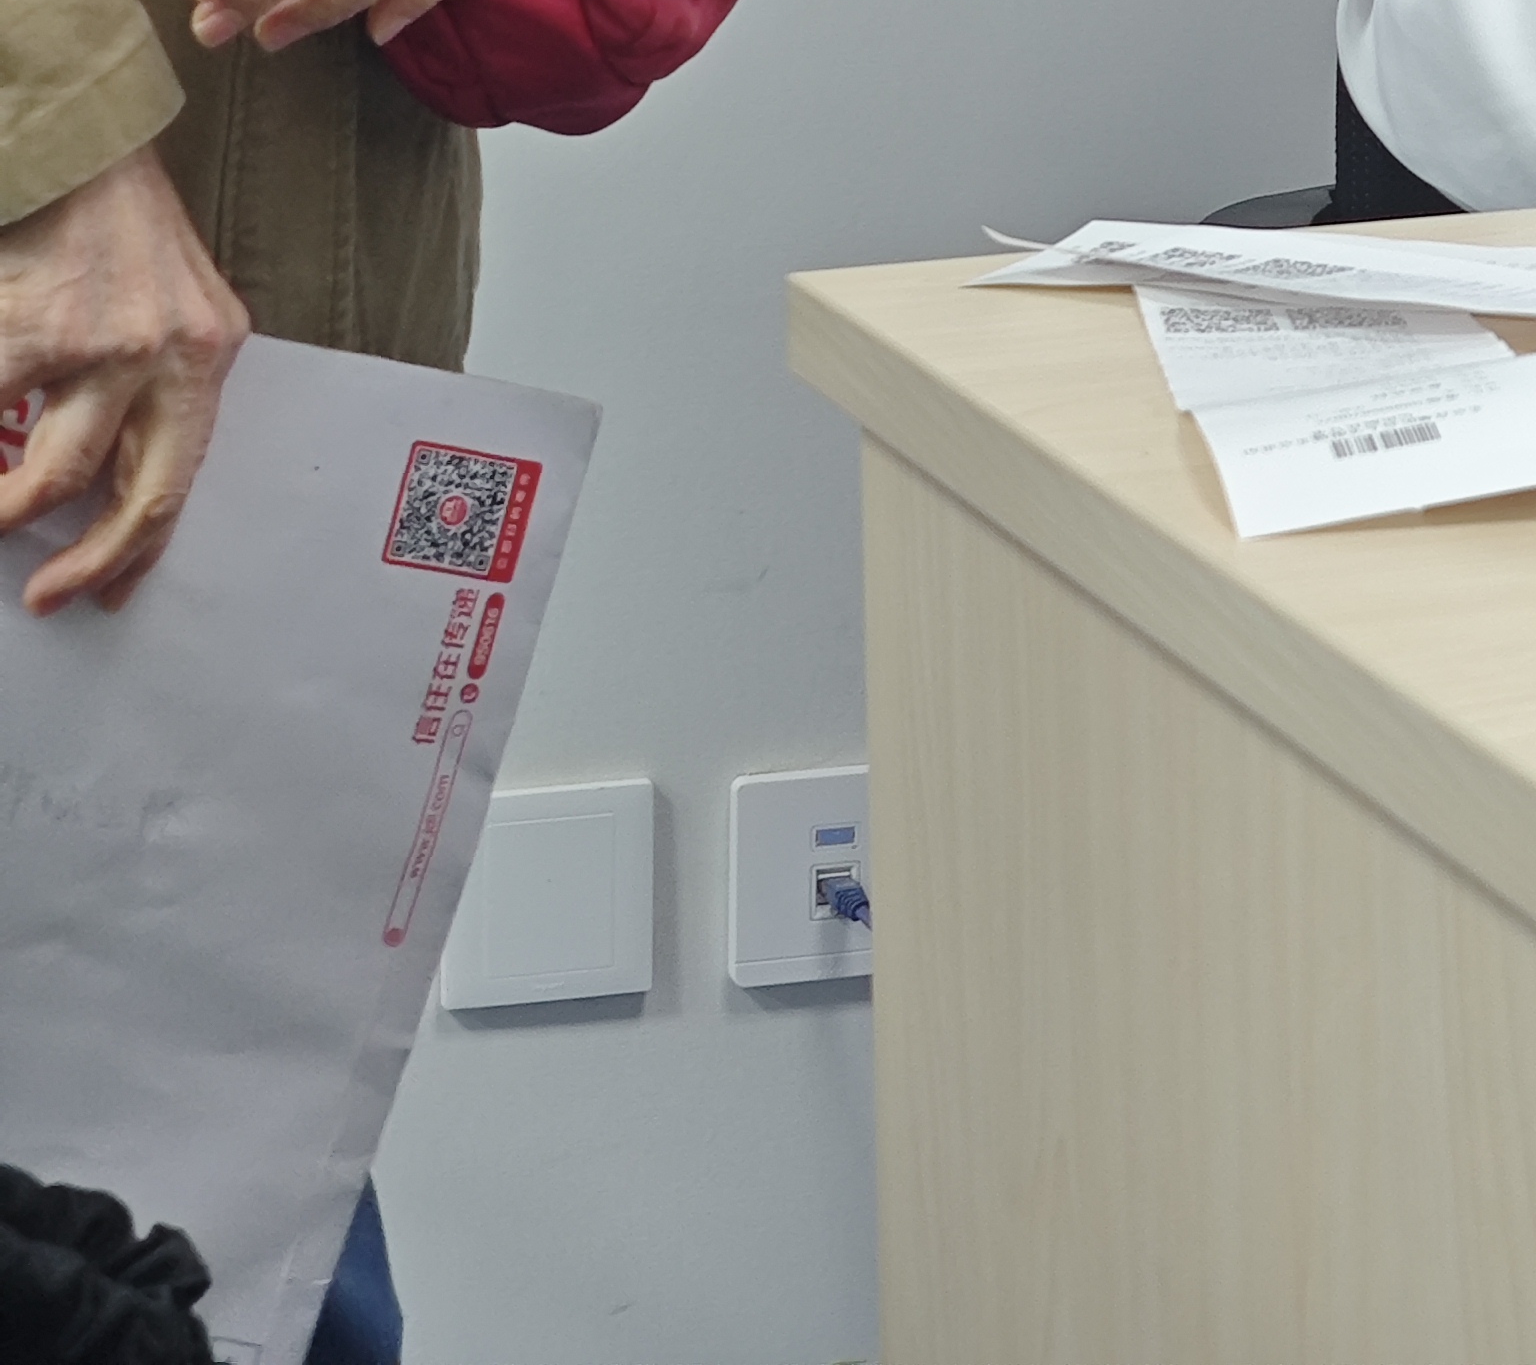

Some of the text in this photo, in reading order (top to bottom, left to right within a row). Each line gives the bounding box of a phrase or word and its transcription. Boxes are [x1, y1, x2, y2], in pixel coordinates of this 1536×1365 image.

[412, 588, 480, 744] 信任在传递
[473, 607, 500, 666] 950616
